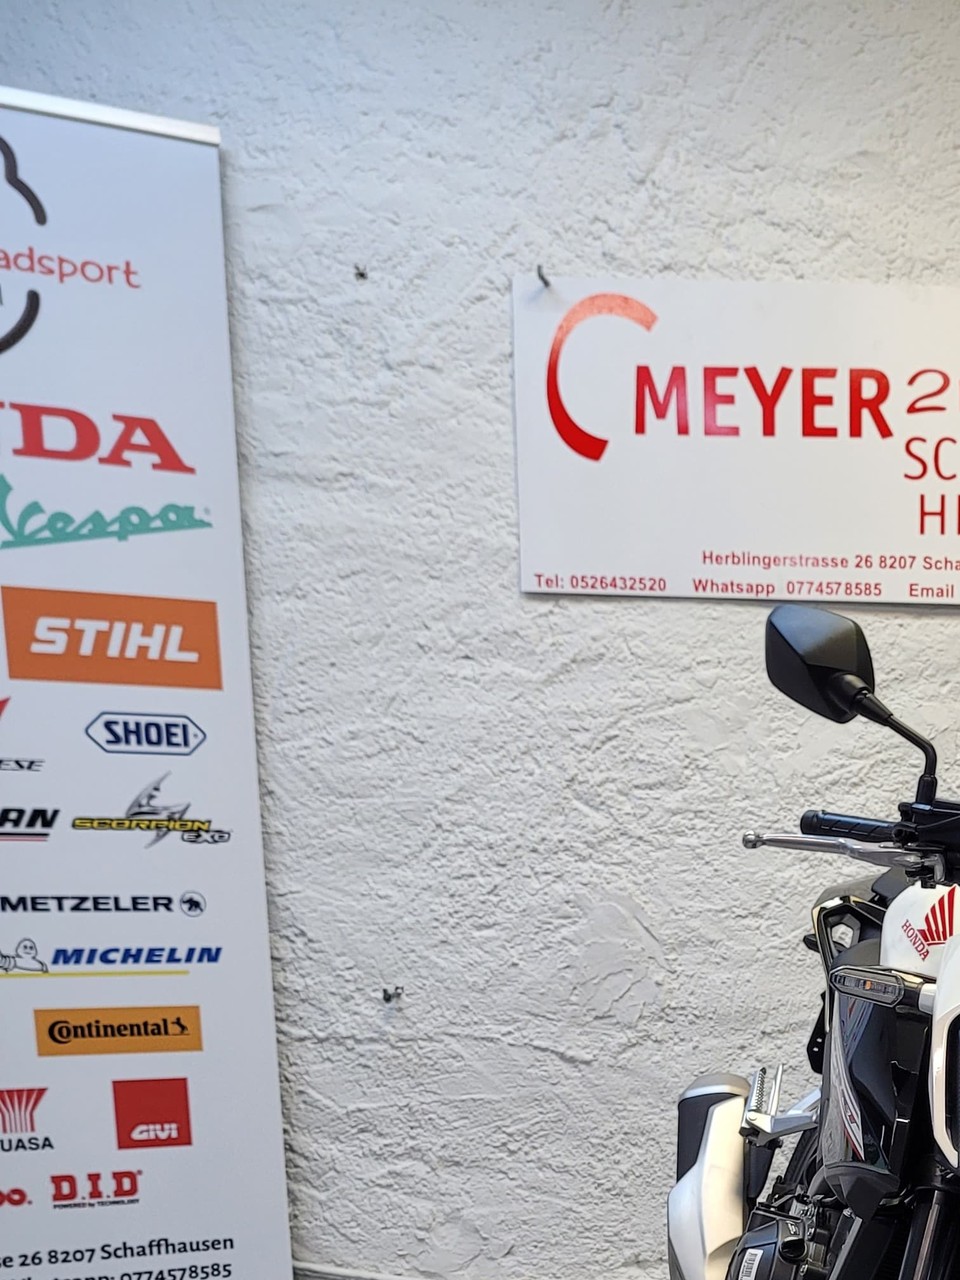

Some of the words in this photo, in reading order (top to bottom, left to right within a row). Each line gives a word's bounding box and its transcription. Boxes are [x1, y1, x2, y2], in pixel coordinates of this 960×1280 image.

[635, 365, 893, 439] MEYER
[702, 551, 849, 568] Herblingerstrasse
[855, 555, 873, 569] 26
[879, 556, 916, 570] 8207
[534, 574, 564, 588] Tel:
[570, 576, 667, 591] 0526432520
[692, 579, 776, 596] Whatsapp
[786, 581, 882, 596] 0774578585
[909, 584, 955, 599] Email
[30, 616, 199, 663] STIHL
[103, 720, 190, 748] SHOEI
[72, 817, 212, 832] SCORPION
[181, 830, 231, 844] EXO
[0, 895, 174, 912] METZELER
[901, 919, 930, 962] HONDA
[51, 947, 223, 966] MICHELIN
[48, 1016, 170, 1045] Continental
[130, 1123, 179, 1141] GIVI
[51, 1171, 138, 1201] D.I.D
[19, 1251, 43, 1266] 26
[48, 1249, 96, 1264] 8207
[101, 1238, 234, 1260] Schaffhausen
